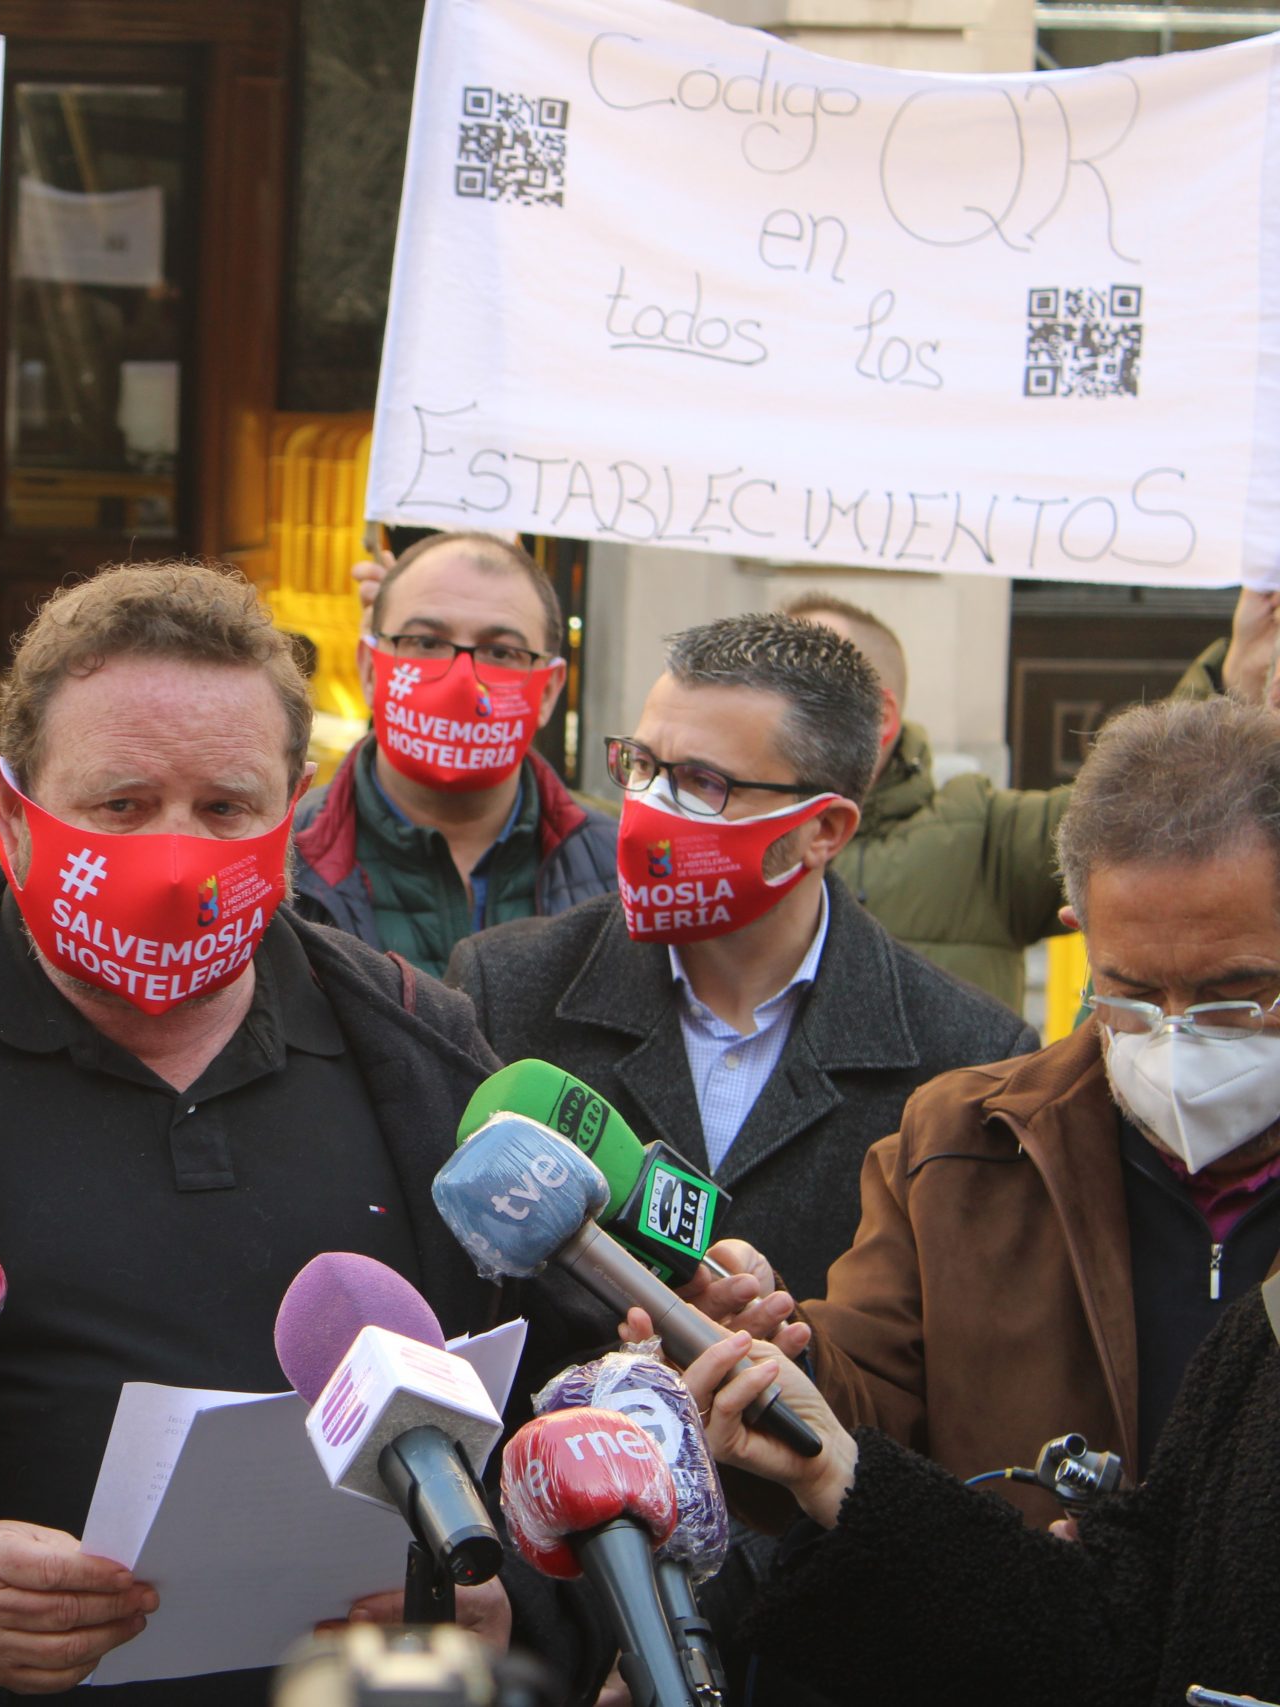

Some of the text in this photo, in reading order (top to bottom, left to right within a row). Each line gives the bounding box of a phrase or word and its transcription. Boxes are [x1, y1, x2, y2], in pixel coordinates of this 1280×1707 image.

[880, 71, 1143, 264] QR
[758, 208, 848, 282] en
[606, 266, 944, 390] todos los
[396, 401, 1198, 568] ESTABLECIMIENTOS
[384, 700, 524, 745] SALVEMOSLA
[386, 726, 517, 770] HOSTELERÍA
[51, 898, 264, 968] SALVEMOSLA
[55, 932, 252, 1001] HOSTELERÍA
[578, 1102, 602, 1147] CERO
[491, 1154, 569, 1221] tve
[650, 1175, 663, 1224] ONDA
[679, 1190, 698, 1245] CERO
[564, 1428, 653, 1461] rne
